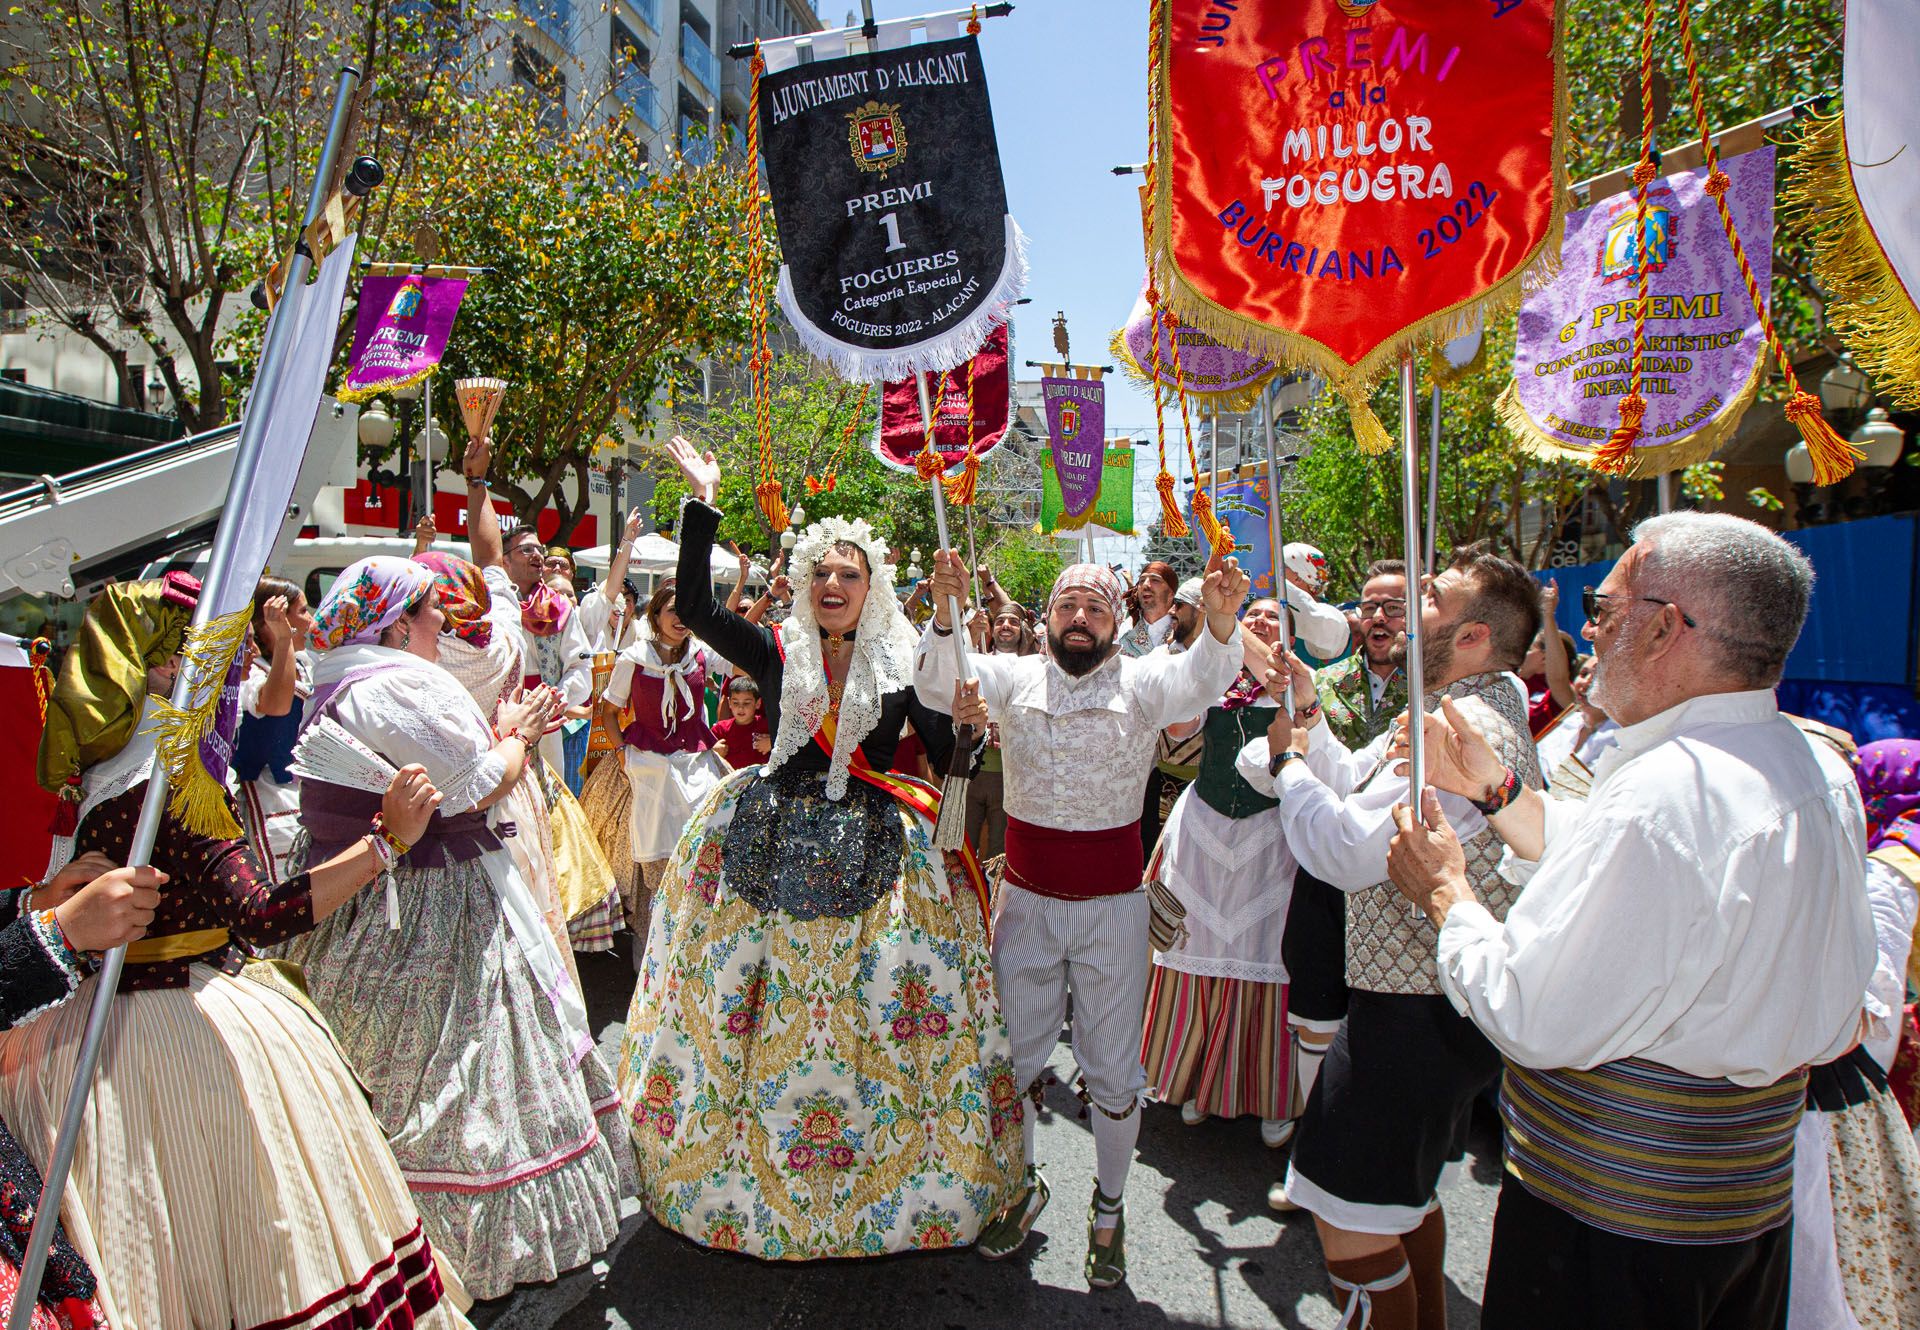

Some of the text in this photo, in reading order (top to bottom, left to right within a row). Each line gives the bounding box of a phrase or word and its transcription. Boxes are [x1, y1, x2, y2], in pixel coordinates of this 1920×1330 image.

[1256, 26, 1460, 101] PREMI
[772, 69, 869, 125] AJUNTAMENT
[1329, 82, 1386, 108] a la
[1282, 115, 1433, 165] MILLOR
[846, 181, 933, 217] PREMI
[1260, 162, 1453, 212] FOGUERA
[878, 212, 907, 253] 1
[1217, 199, 1404, 280] BURRIANA
[1417, 181, 1498, 260] 2022
[840, 250, 960, 294] FOGUERES
[844, 270, 963, 313] Categoría Especial
[830, 310, 893, 338] FOGUERES
[895, 319, 923, 337] 2022
[932, 275, 981, 324] ALACANT
[1592, 292, 1723, 329] PREMI
[374, 327, 430, 348] PREMI
[1535, 336, 1630, 377] CONCURSO
[1196, 374, 1222, 385] 2022
[1573, 357, 1693, 383] MODAIDAD
[1656, 397, 1723, 438] ALACANT
